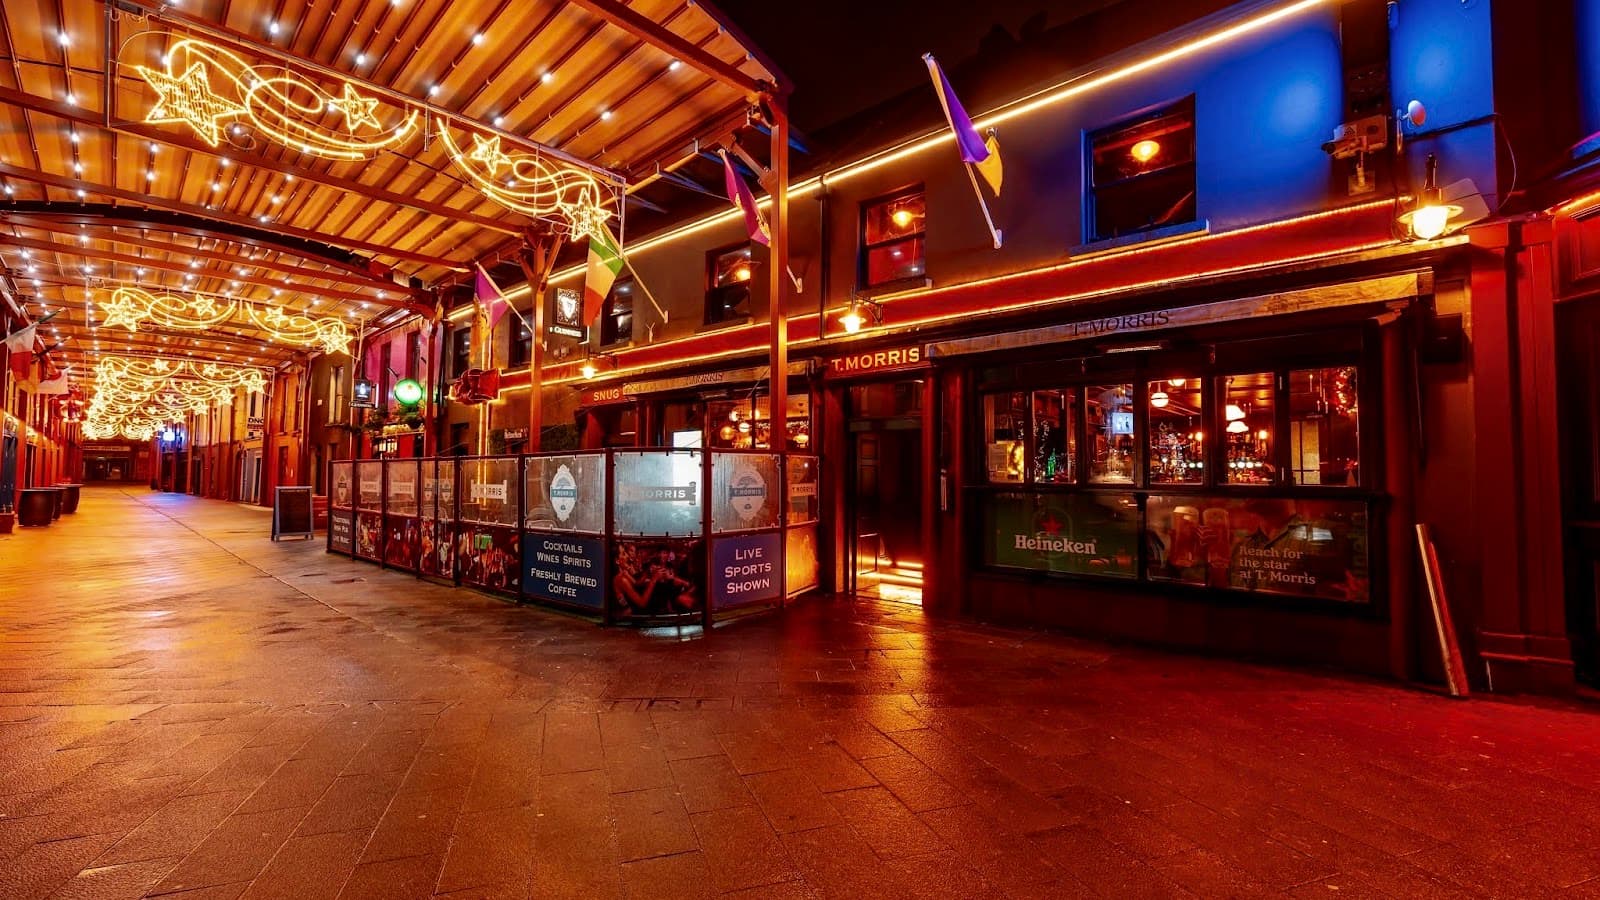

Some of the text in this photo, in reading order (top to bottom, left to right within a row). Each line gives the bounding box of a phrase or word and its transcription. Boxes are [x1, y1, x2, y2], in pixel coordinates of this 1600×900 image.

[831, 347, 920, 371] T.MORRIS
[593, 389, 620, 401] SNUG
[543, 541, 583, 554] COCKTAILS
[1015, 534, 1096, 555] Heineken
[536, 552, 592, 568] WINES SPIRITS
[735, 548, 762, 560] LIVE
[1239, 546, 1304, 559] Reach for
[725, 562, 772, 578] SPORTS
[1239, 557, 1290, 570] the star
[530, 567, 597, 588] FRESHLY BREWED
[1239, 570, 1251, 579] at
[1270, 571, 1316, 585] Morris
[548, 583, 577, 597] COFFEE
[726, 578, 770, 594] SHOWN
